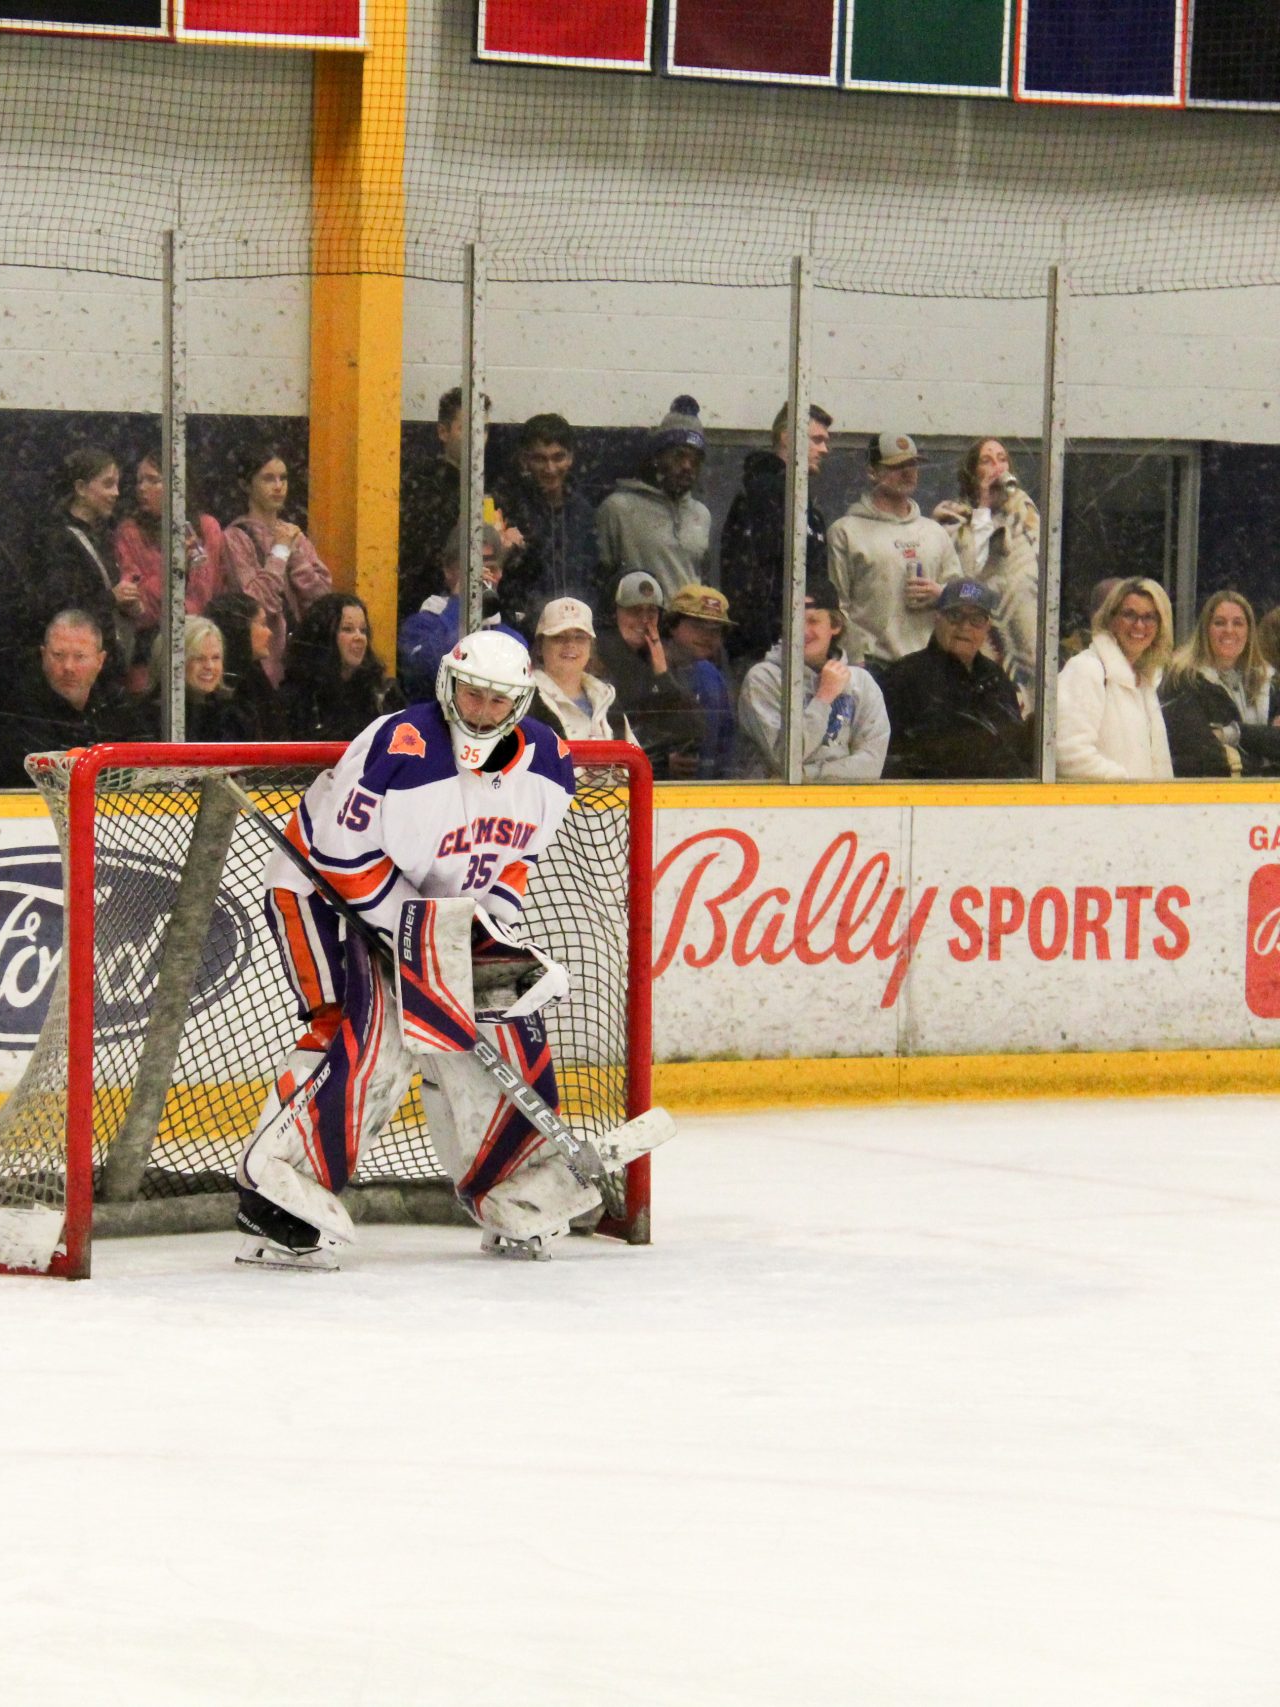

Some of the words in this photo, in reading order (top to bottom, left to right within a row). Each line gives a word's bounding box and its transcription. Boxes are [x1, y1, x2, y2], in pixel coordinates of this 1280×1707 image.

[460, 745, 480, 763] 35
[436, 816, 538, 859] CLMSON
[461, 853, 499, 891] 35
[404, 904, 417, 962] BAUER
[651, 828, 938, 1009] Bally
[947, 885, 1191, 962] SPORTS
[474, 1041, 580, 1157] BAUER
